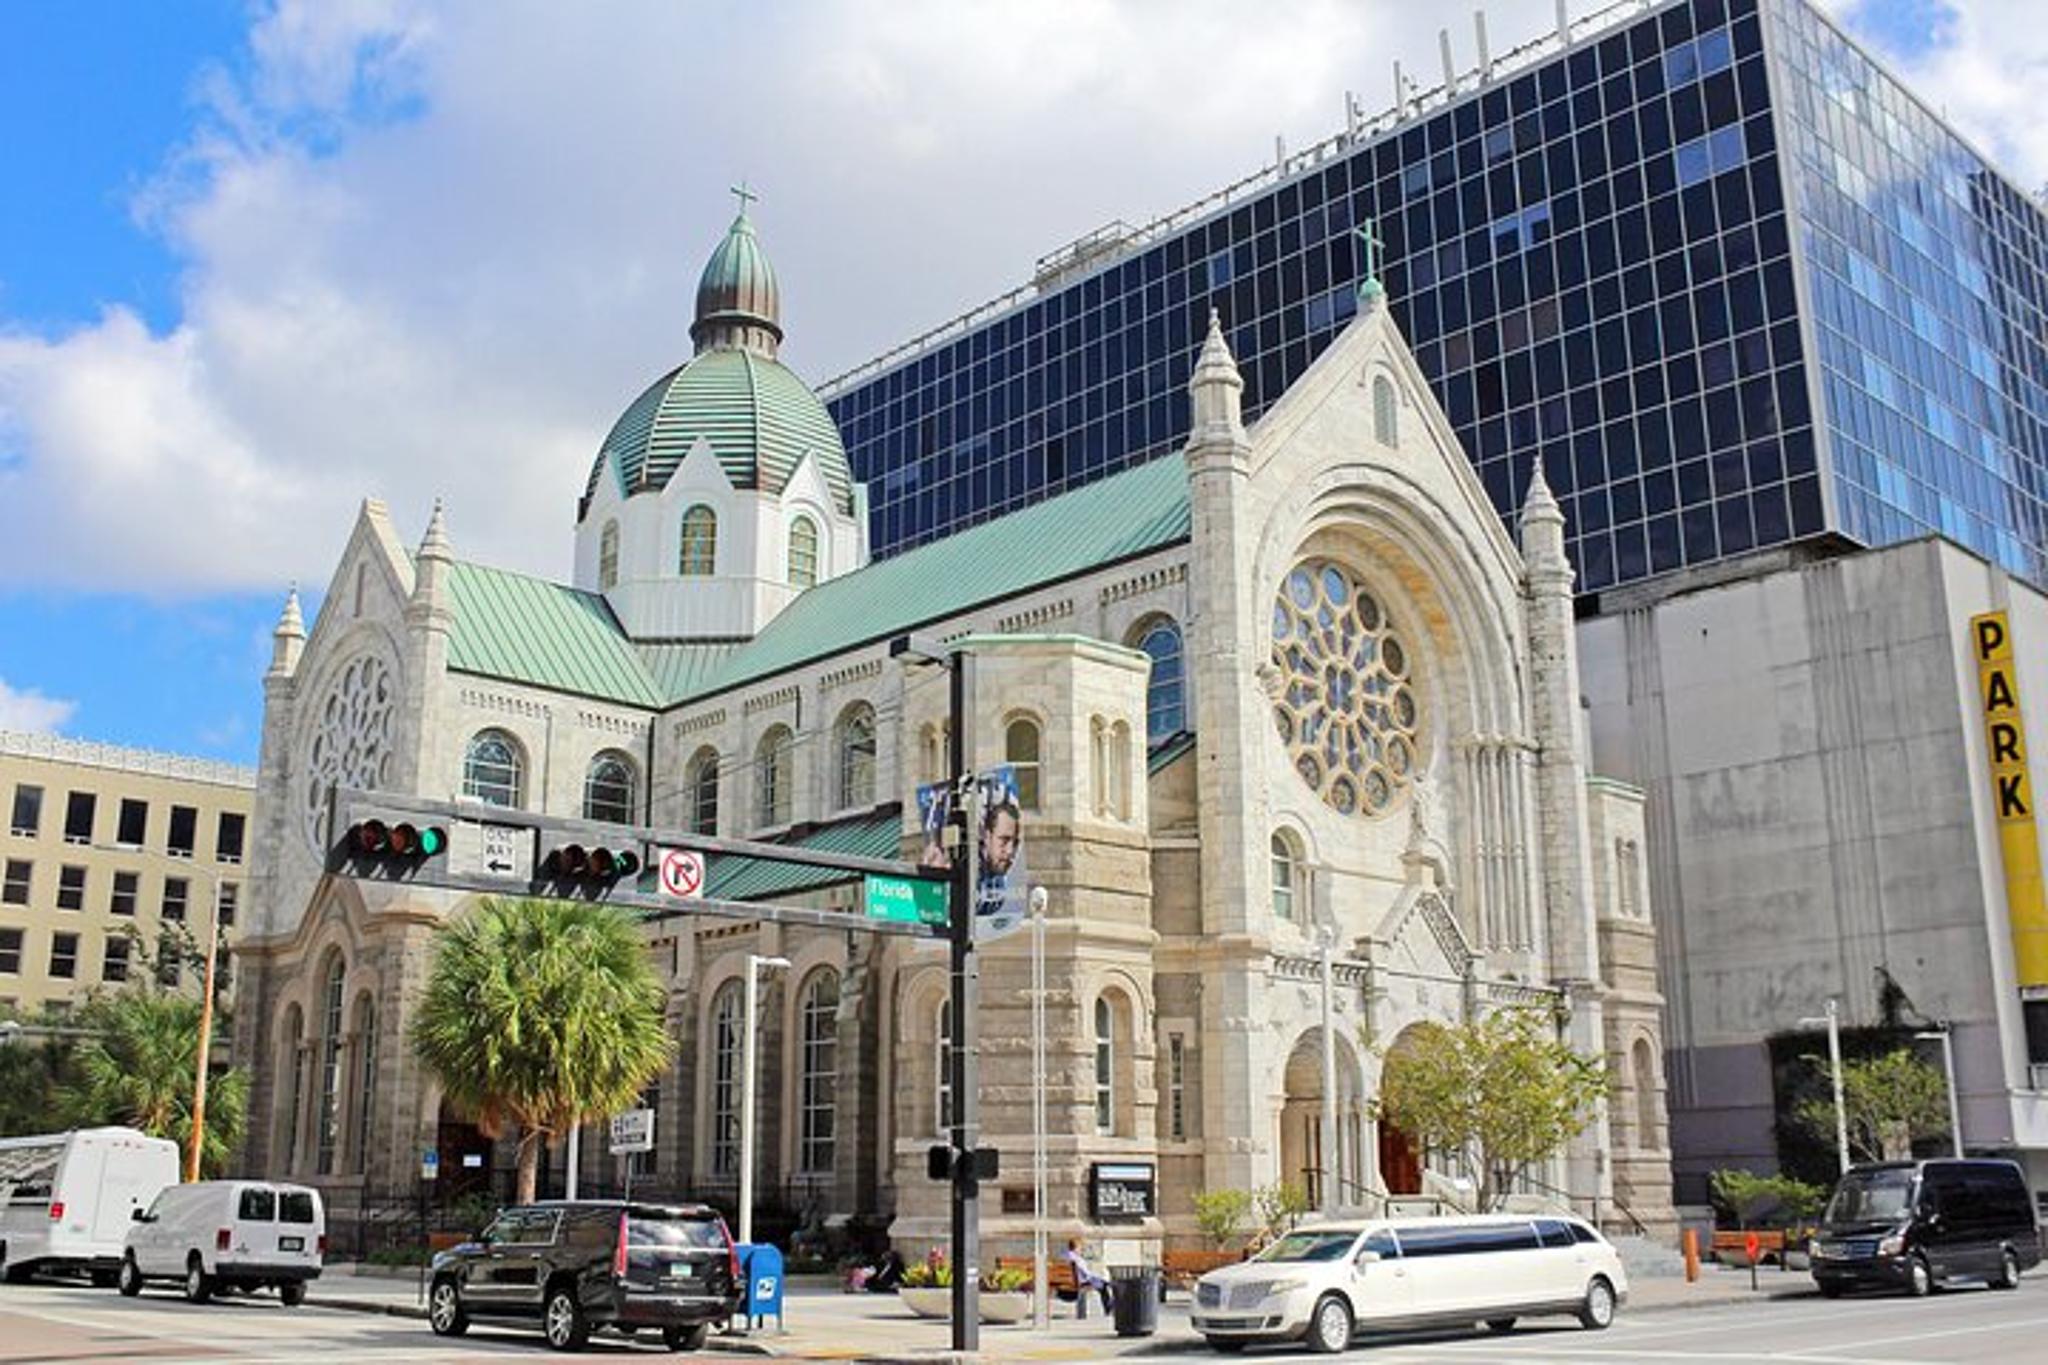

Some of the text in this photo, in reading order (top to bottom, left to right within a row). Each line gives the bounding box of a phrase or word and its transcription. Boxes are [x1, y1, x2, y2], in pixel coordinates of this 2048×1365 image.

[1977, 618, 2028, 818] PARK
[486, 844, 513, 856] WAY
[871, 878, 914, 901] Florida
